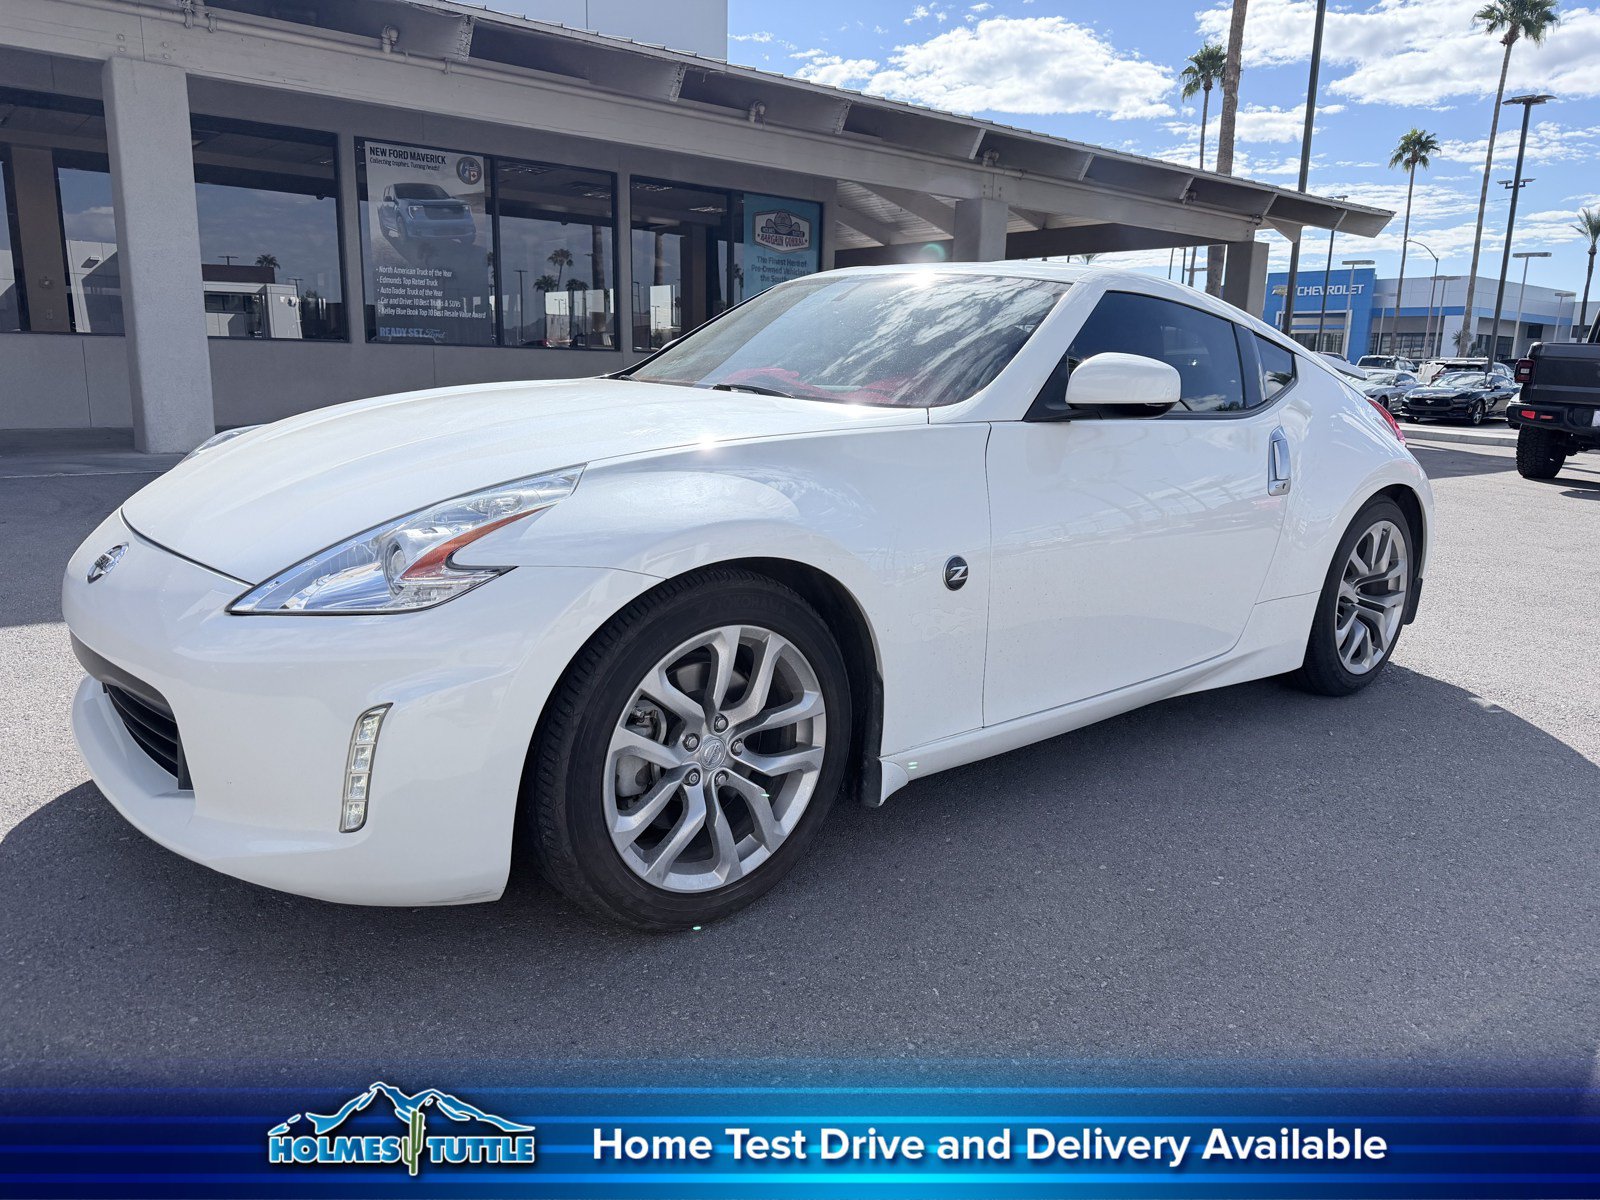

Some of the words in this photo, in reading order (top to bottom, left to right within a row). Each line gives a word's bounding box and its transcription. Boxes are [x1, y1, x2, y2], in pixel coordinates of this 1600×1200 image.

[369, 147, 387, 157] NEW
[388, 149, 409, 160] FORD
[409, 152, 447, 164] MAVERICK
[370, 157, 392, 166] Collecting
[756, 256, 768, 264] The
[379, 266, 393, 274] North
[394, 267, 416, 275] American
[416, 268, 428, 276] Truck
[428, 269, 435, 277] of
[434, 269, 442, 277] the
[442, 270, 452, 278] Year
[380, 276, 402, 284] Edmunds
[402, 277, 411, 286] Top
[412, 278, 425, 286] Rated
[407, 288, 418, 296] Truck
[419, 289, 425, 297] of
[433, 289, 443, 297] Year
[1296, 284, 1364, 296] CHEVROLET
[389, 297, 399, 305] and
[420, 298, 430, 306] Best
[449, 300, 461, 308] SUVs
[381, 306, 396, 316] Kelley
[396, 307, 406, 315] Blue
[406, 308, 418, 316] Book
[419, 308, 428, 317] Top
[434, 309, 444, 317] Best
[379, 327, 407, 337] READY
[408, 328, 423, 338] SET
[948, 565, 968, 582] Z
